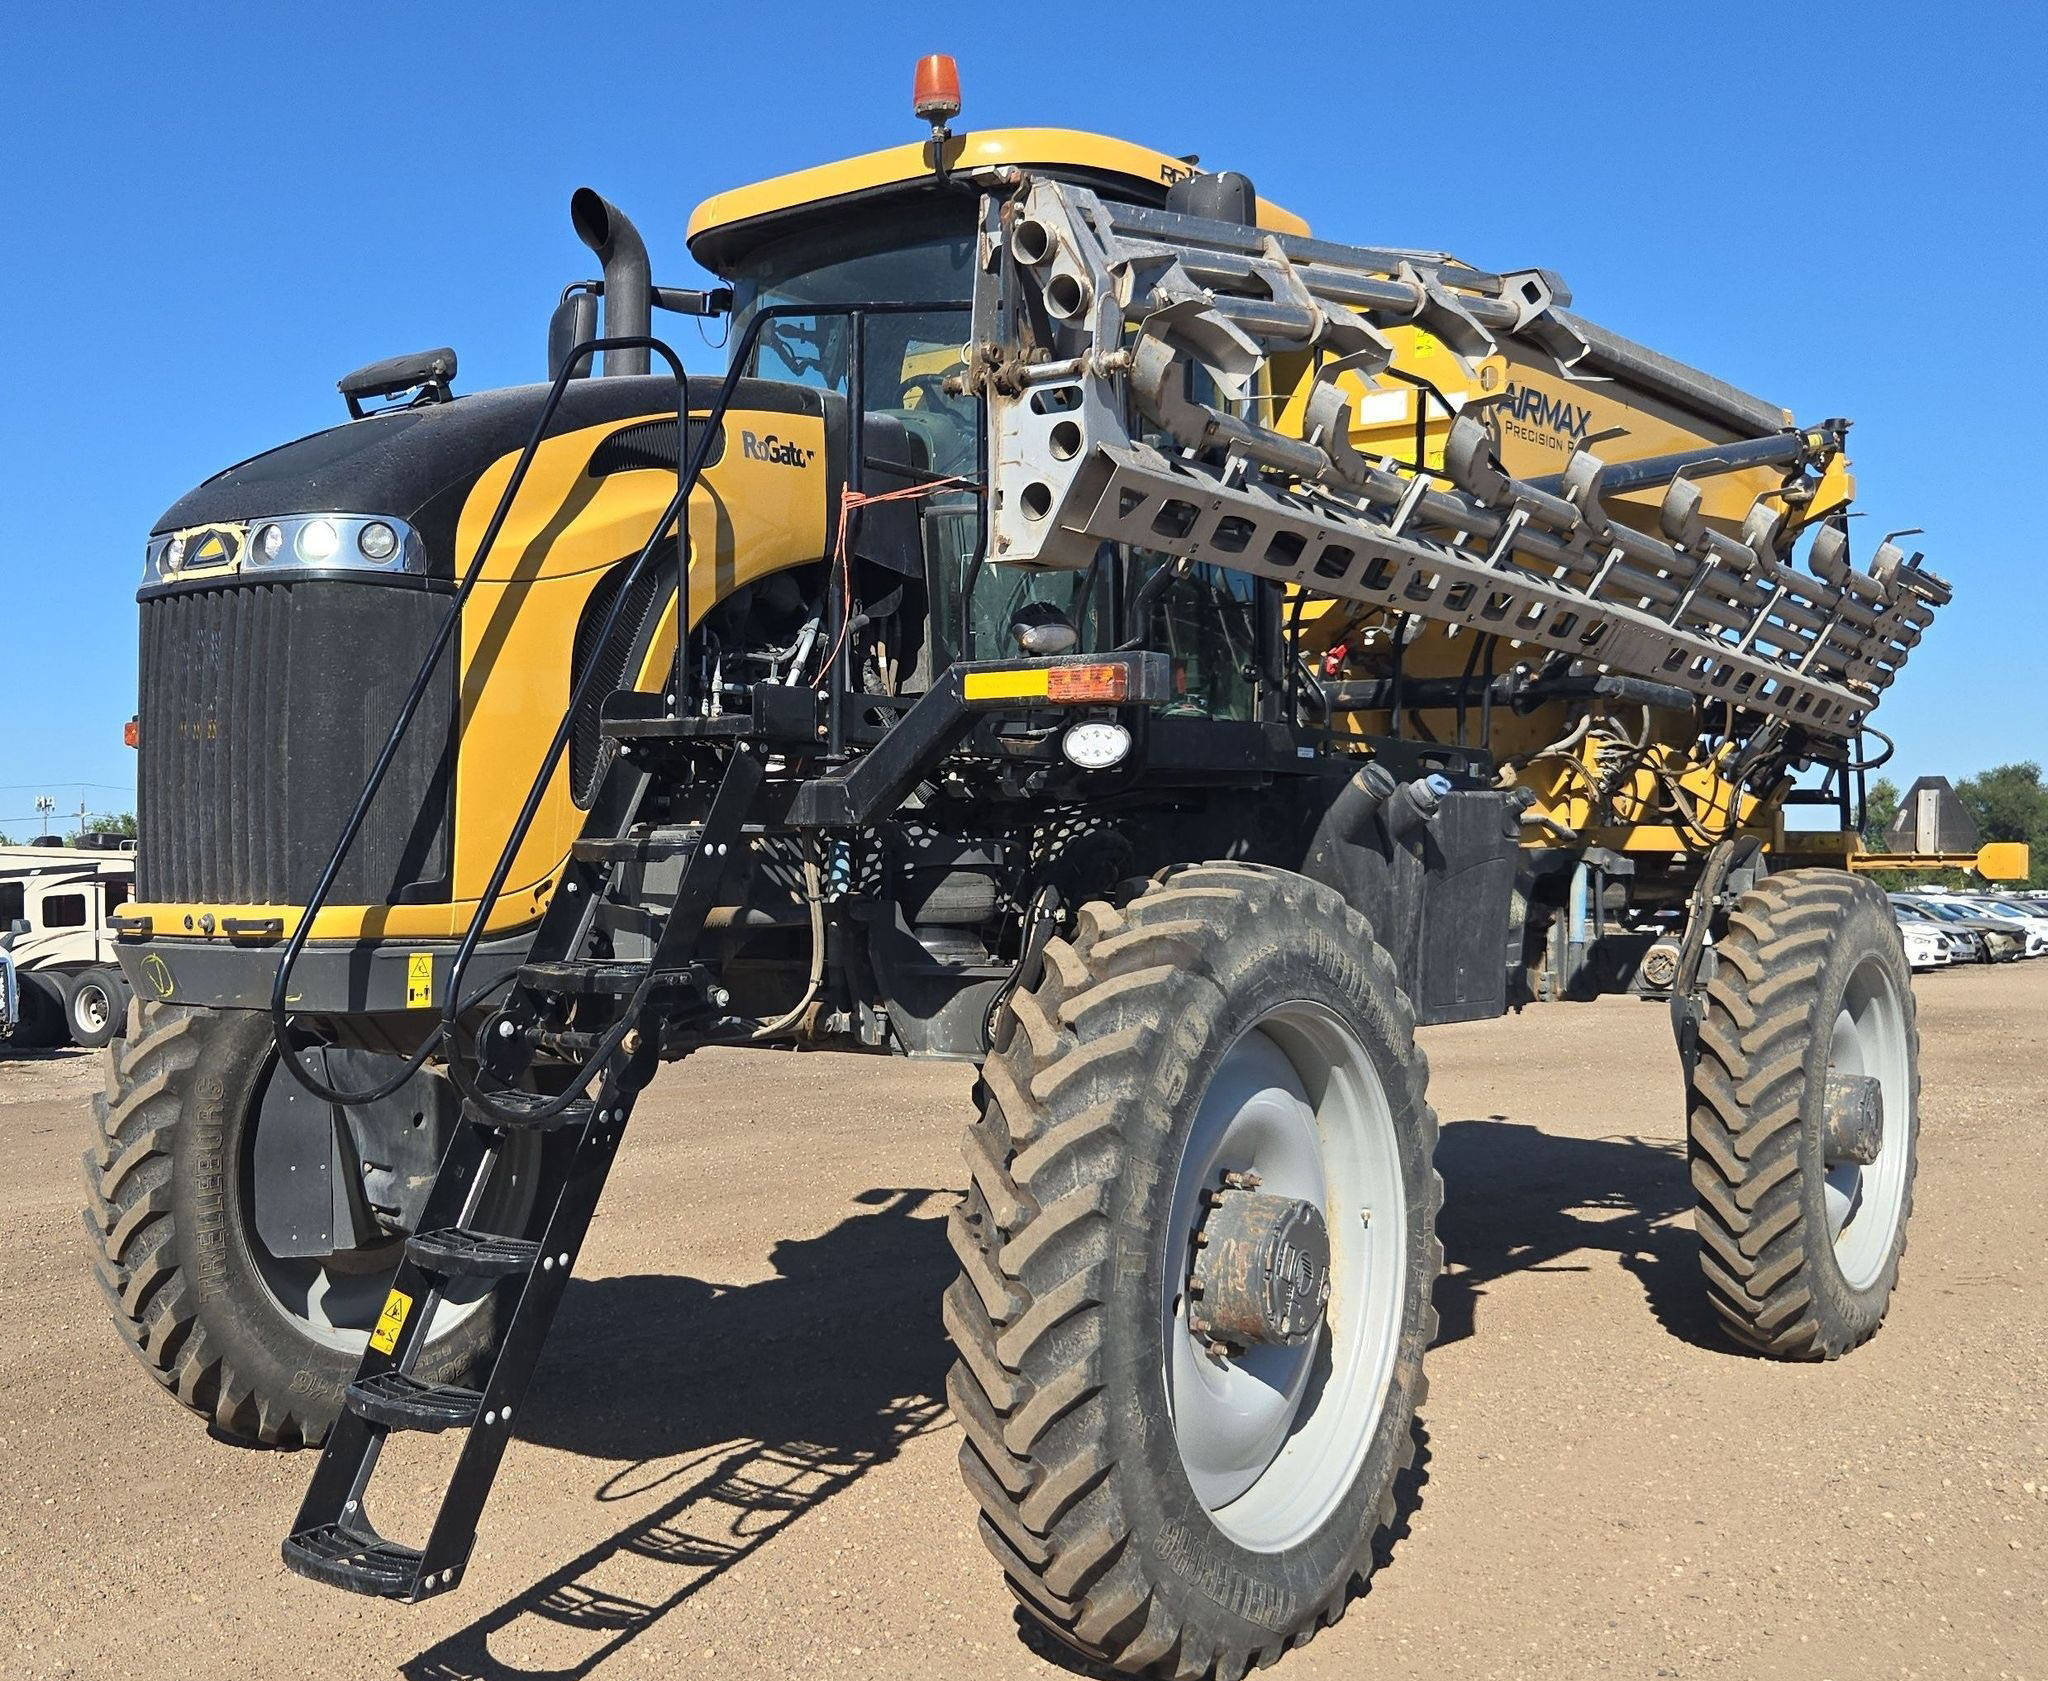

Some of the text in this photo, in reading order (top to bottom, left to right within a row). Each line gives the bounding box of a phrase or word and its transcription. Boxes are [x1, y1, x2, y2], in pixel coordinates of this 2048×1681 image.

[1497, 382, 1592, 437] AIRMAX
[1505, 420, 1563, 451] PRECISION
[195, 1077, 229, 1304] TRELLEBORG
